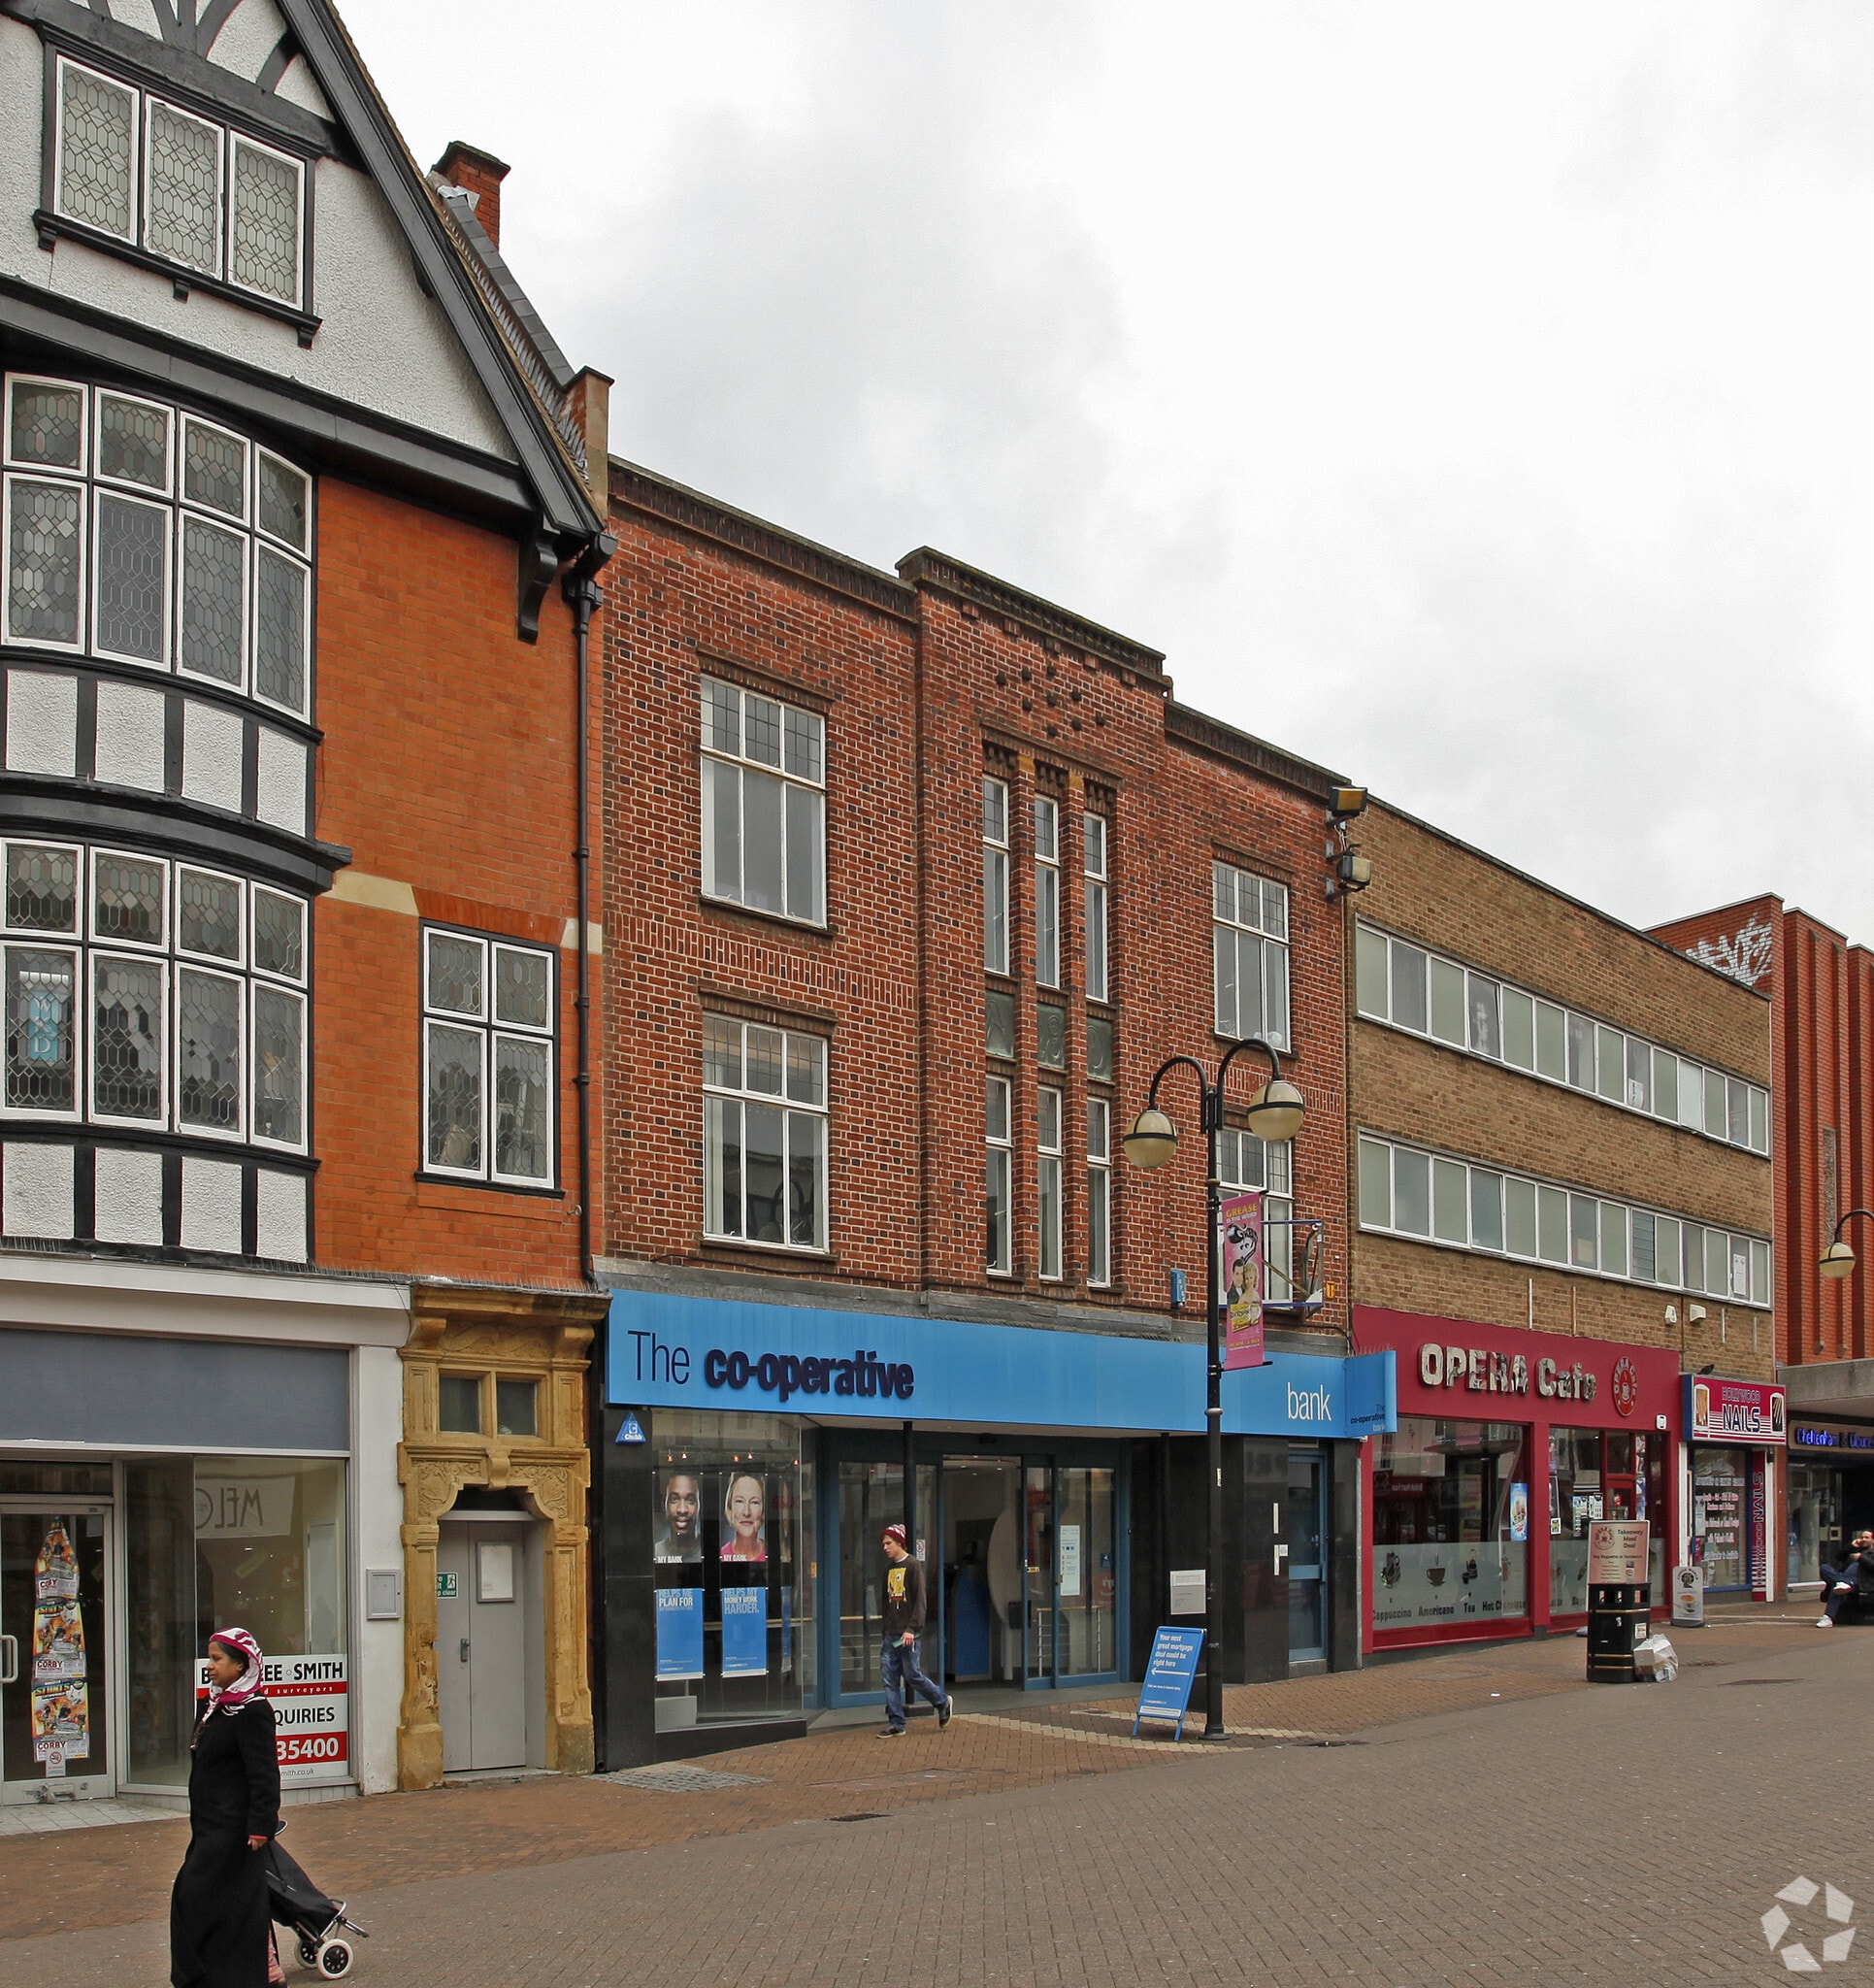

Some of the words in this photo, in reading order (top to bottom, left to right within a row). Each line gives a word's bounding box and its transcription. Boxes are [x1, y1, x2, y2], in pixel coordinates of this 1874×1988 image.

[34, 1036, 51, 1053] D
[1226, 1204, 1258, 1217] GREASE
[627, 1330, 690, 1384] The
[705, 1348, 915, 1402] co-operative
[1287, 1381, 1332, 1421] bank
[1420, 1342, 1529, 1394] OPERA
[1537, 1357, 1597, 1400] Cafe
[1722, 1386, 1761, 1405] HOLLYWOOD
[1722, 1403, 1761, 1434] NAILS
[1796, 1428, 1839, 1447] Cheltenham
[1752, 1472, 1764, 1522] NAILS
[659, 1589, 681, 1598] HELPS
[724, 1588, 745, 1597] HELPS
[659, 1598, 678, 1607] PLAN
[678, 1597, 693, 1606] FOR
[724, 1603, 760, 1614] HARDER.
[1418, 1605, 1455, 1617] Americano
[1463, 1602, 1475, 1612] Tea
[1482, 1602, 1495, 1611] Hot
[1170, 1643, 1194, 1652] mortgage
[293, 1661, 344, 1680] SMITH
[1152, 1659, 1165, 1668] right
[277, 1685, 334, 1695] surveyors
[274, 1706, 335, 1726] QUIRIES
[37, 1741, 67, 1750] CORBY
[277, 1737, 339, 1761] 35400
[281, 1767, 314, 1777] mith.co.uk
